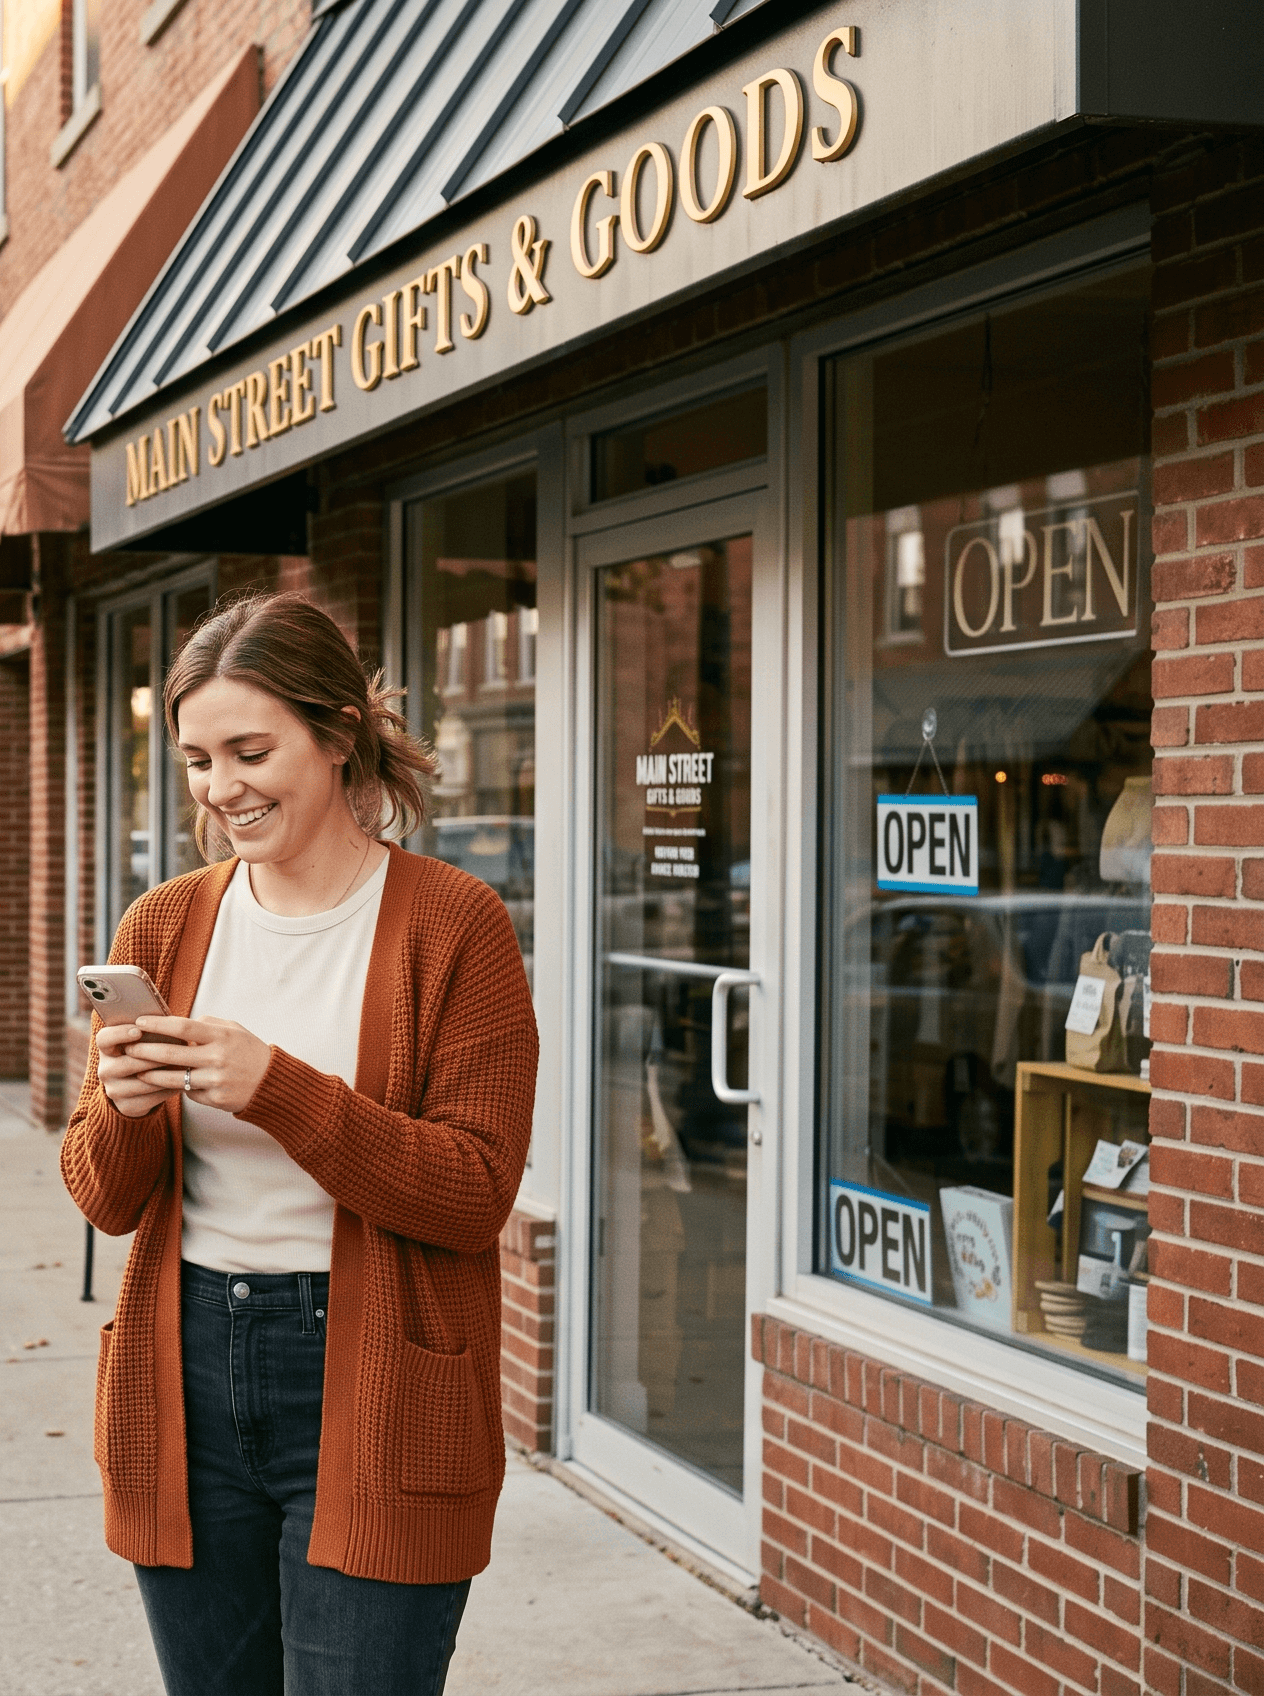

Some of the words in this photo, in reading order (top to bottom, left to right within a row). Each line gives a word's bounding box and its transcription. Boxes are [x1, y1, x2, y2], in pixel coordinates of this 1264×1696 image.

[125, 406, 201, 506] MAIN
[208, 324, 342, 467] STREET
[350, 242, 489, 391] GIFTS
[508, 214, 551, 315] &
[570, 25, 859, 279] GOODS
[953, 510, 1134, 638] OPEN
[636, 755, 667, 785] MAIN
[668, 752, 714, 784] STREET
[884, 810, 970, 878] OPEN
[836, 1193, 926, 1294] OPEN
